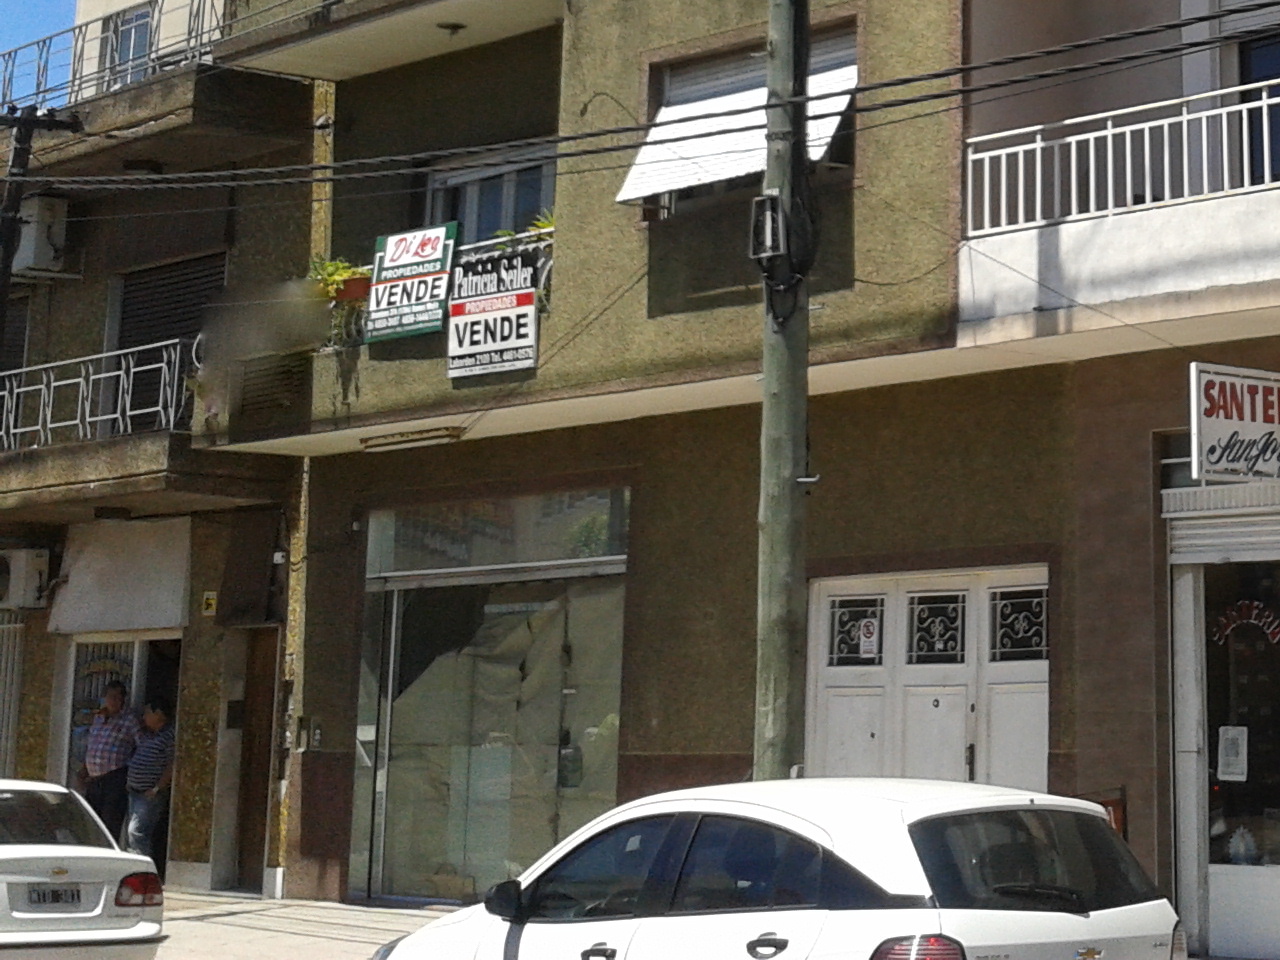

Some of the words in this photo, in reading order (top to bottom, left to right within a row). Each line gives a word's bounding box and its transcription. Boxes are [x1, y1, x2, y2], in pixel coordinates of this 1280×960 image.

[389, 237, 413, 263] Di
[413, 232, 441, 258] Leo
[381, 261, 441, 280] PROPIEDADES
[453, 263, 498, 299] Patricia
[499, 256, 533, 291] Seiler
[375, 276, 443, 308] VENDE
[465, 295, 517, 314] PROPIEDADES
[455, 313, 529, 348] VENDE
